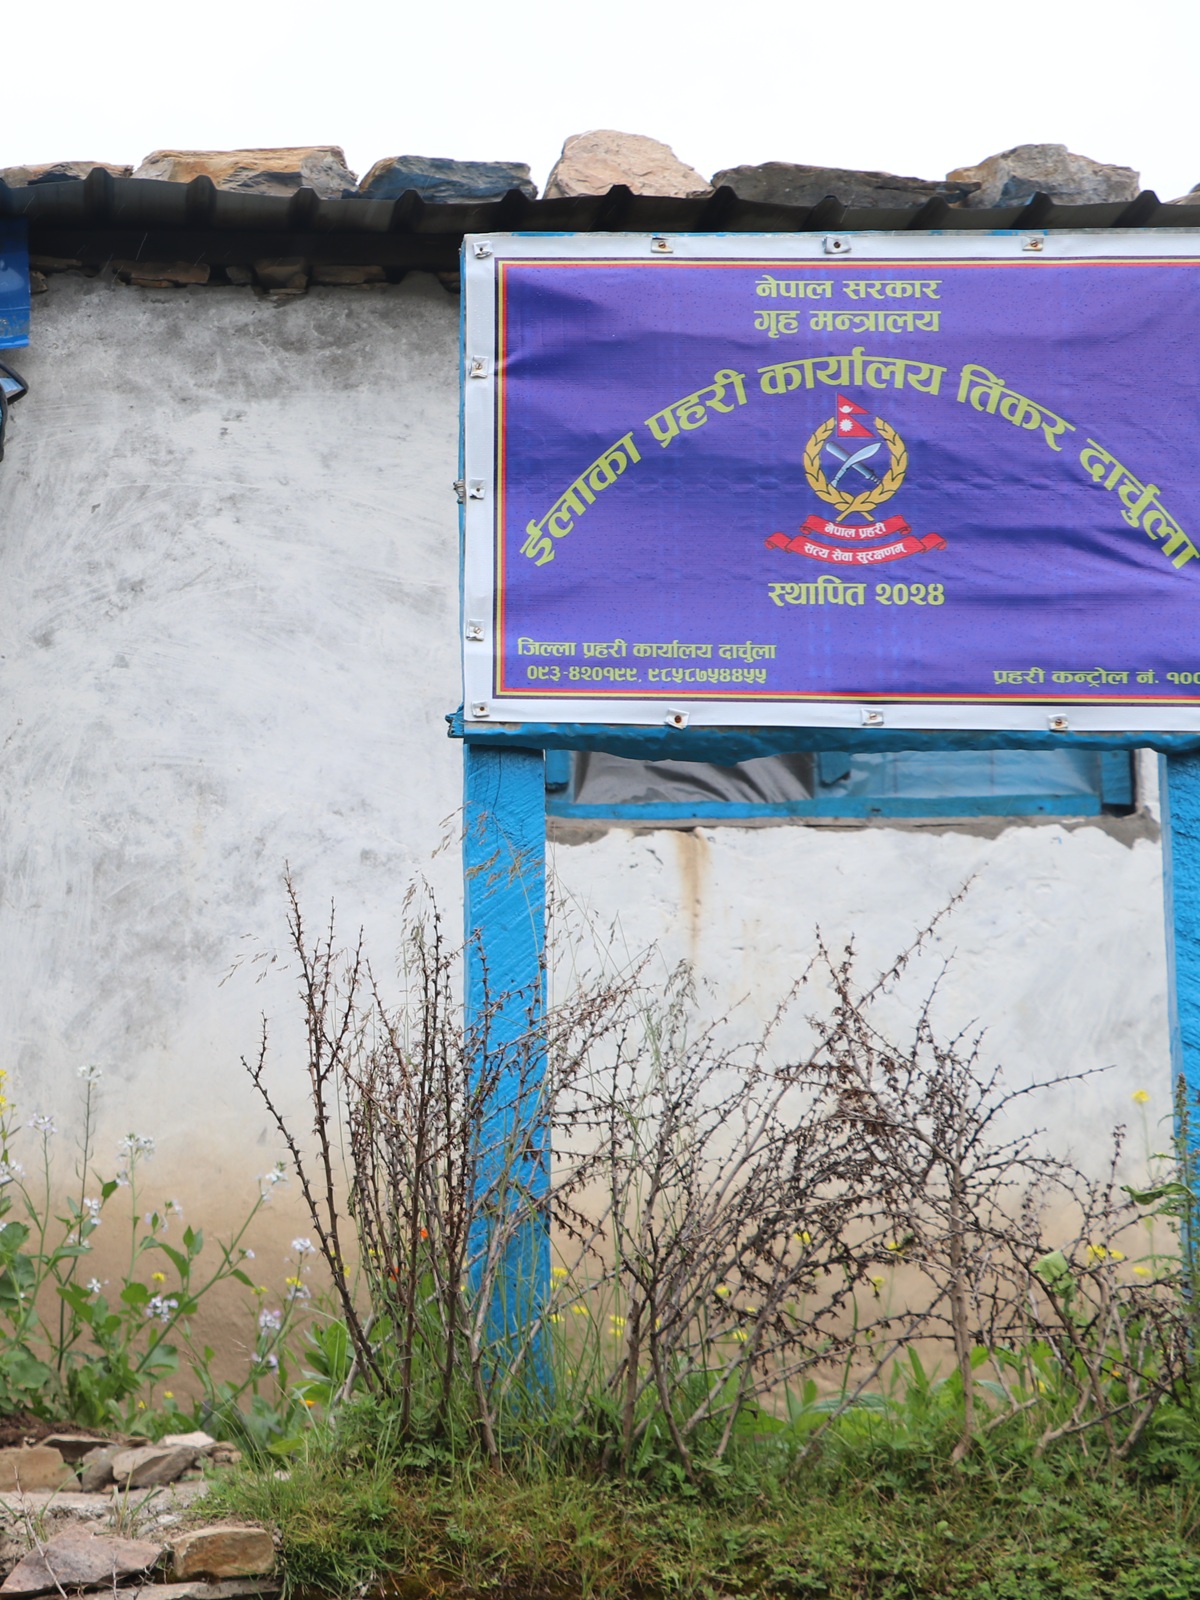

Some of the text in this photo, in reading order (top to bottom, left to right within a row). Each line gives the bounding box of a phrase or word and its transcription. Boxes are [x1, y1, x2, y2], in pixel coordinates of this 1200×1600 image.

[755, 274, 943, 300] नेपाल सरकार
[753, 310, 942, 339] गृह मन्त्रालय
[519, 346, 1200, 570] ईलाका प्रहरी कार्यालय तिंकर दार्चुला
[824, 521, 887, 539] नेपाल प्रहरी
[804, 542, 908, 565] सत्य सेवा सुरक्षणम्
[767, 574, 946, 607] स्थापित २०२४
[517, 637, 777, 664] जिल्ला प्रहरी कार्यालय दार्चुला
[648, 667, 768, 684] ९८५८७५४४५५
[992, 666, 1046, 685] प्रहरी
[1051, 666, 1130, 688] कन्ट्रोल
[1135, 668, 1160, 685] नं.
